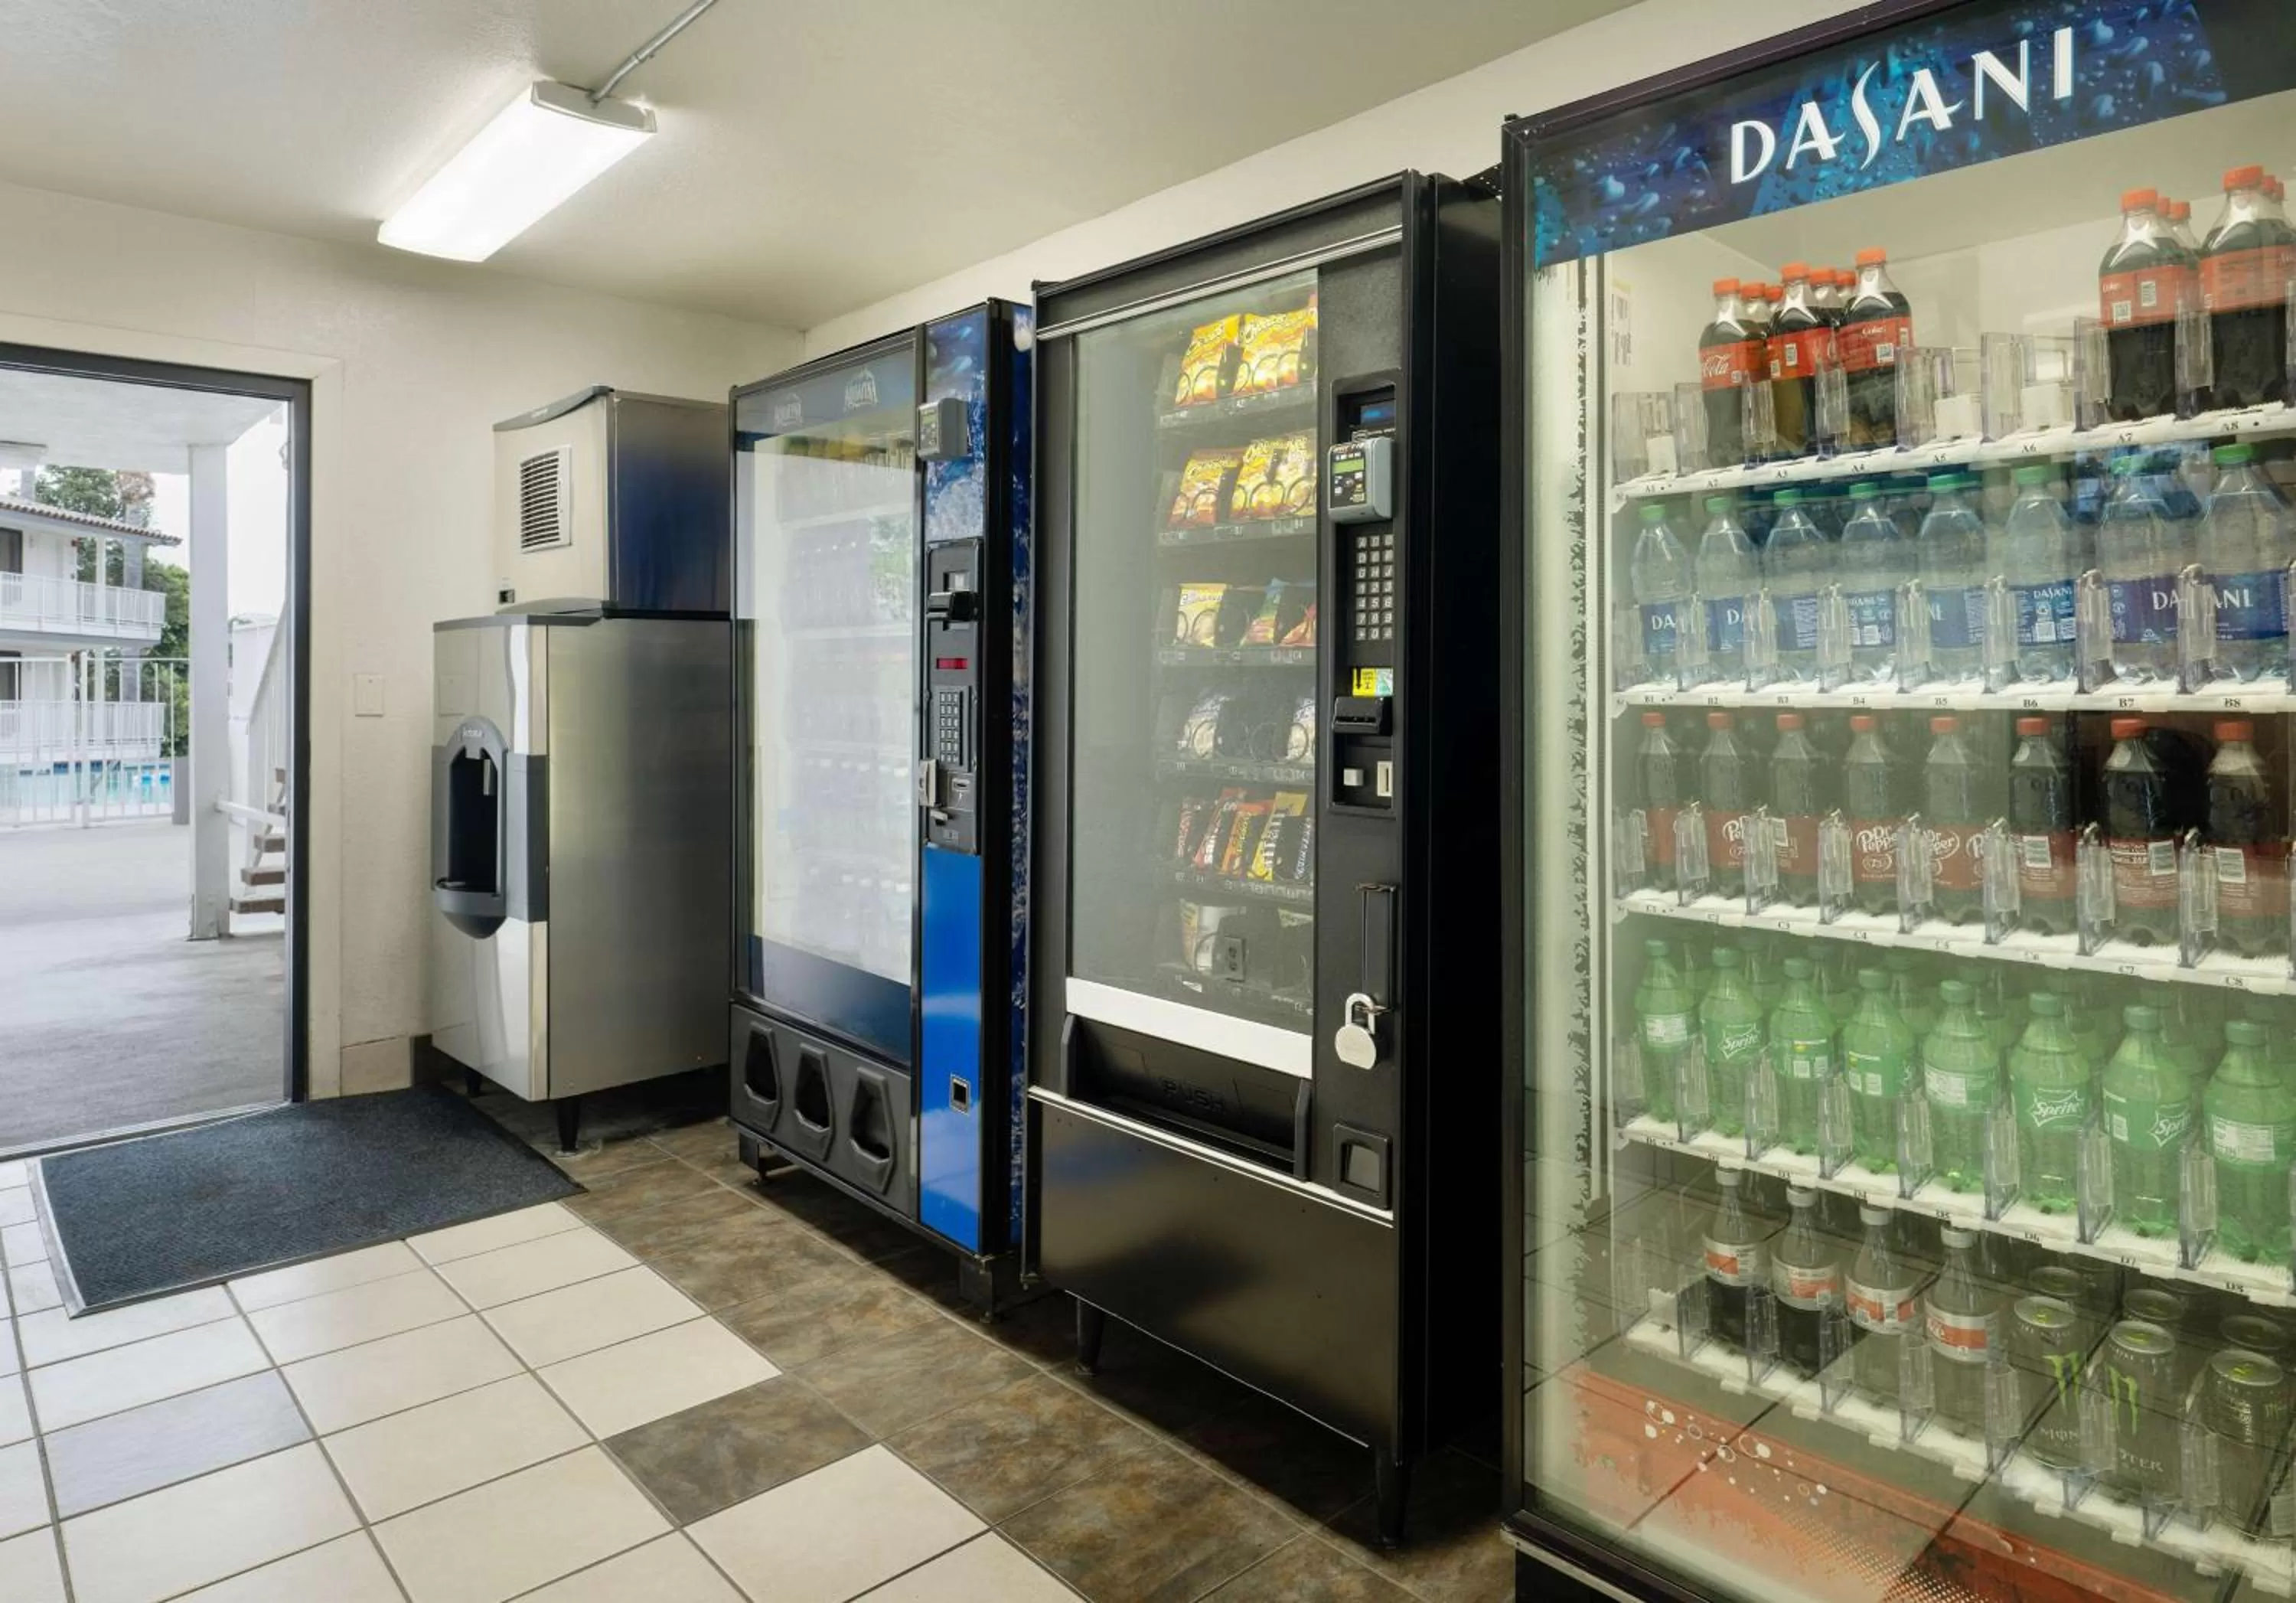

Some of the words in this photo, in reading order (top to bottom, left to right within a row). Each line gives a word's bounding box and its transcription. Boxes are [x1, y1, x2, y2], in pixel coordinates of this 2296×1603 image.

[1730, 26, 2073, 184] DASANI
[1776, 469, 1788, 478] A3
[2022, 442, 2037, 453] A6
[2118, 432, 2132, 443] A7
[2223, 420, 2239, 432] A8
[2033, 586, 2073, 599] DASANI
[1852, 697, 1865, 705] B4
[1935, 697, 1948, 706] B5
[2023, 698, 2038, 708] B6
[2118, 698, 2135, 708] B7
[2224, 697, 2241, 708] B8
[2118, 965, 2135, 975] C7
[2226, 976, 2243, 987] C8
[1163, 1078, 1225, 1115] PUSH
[2034, 1101, 2081, 1118] Sprite
